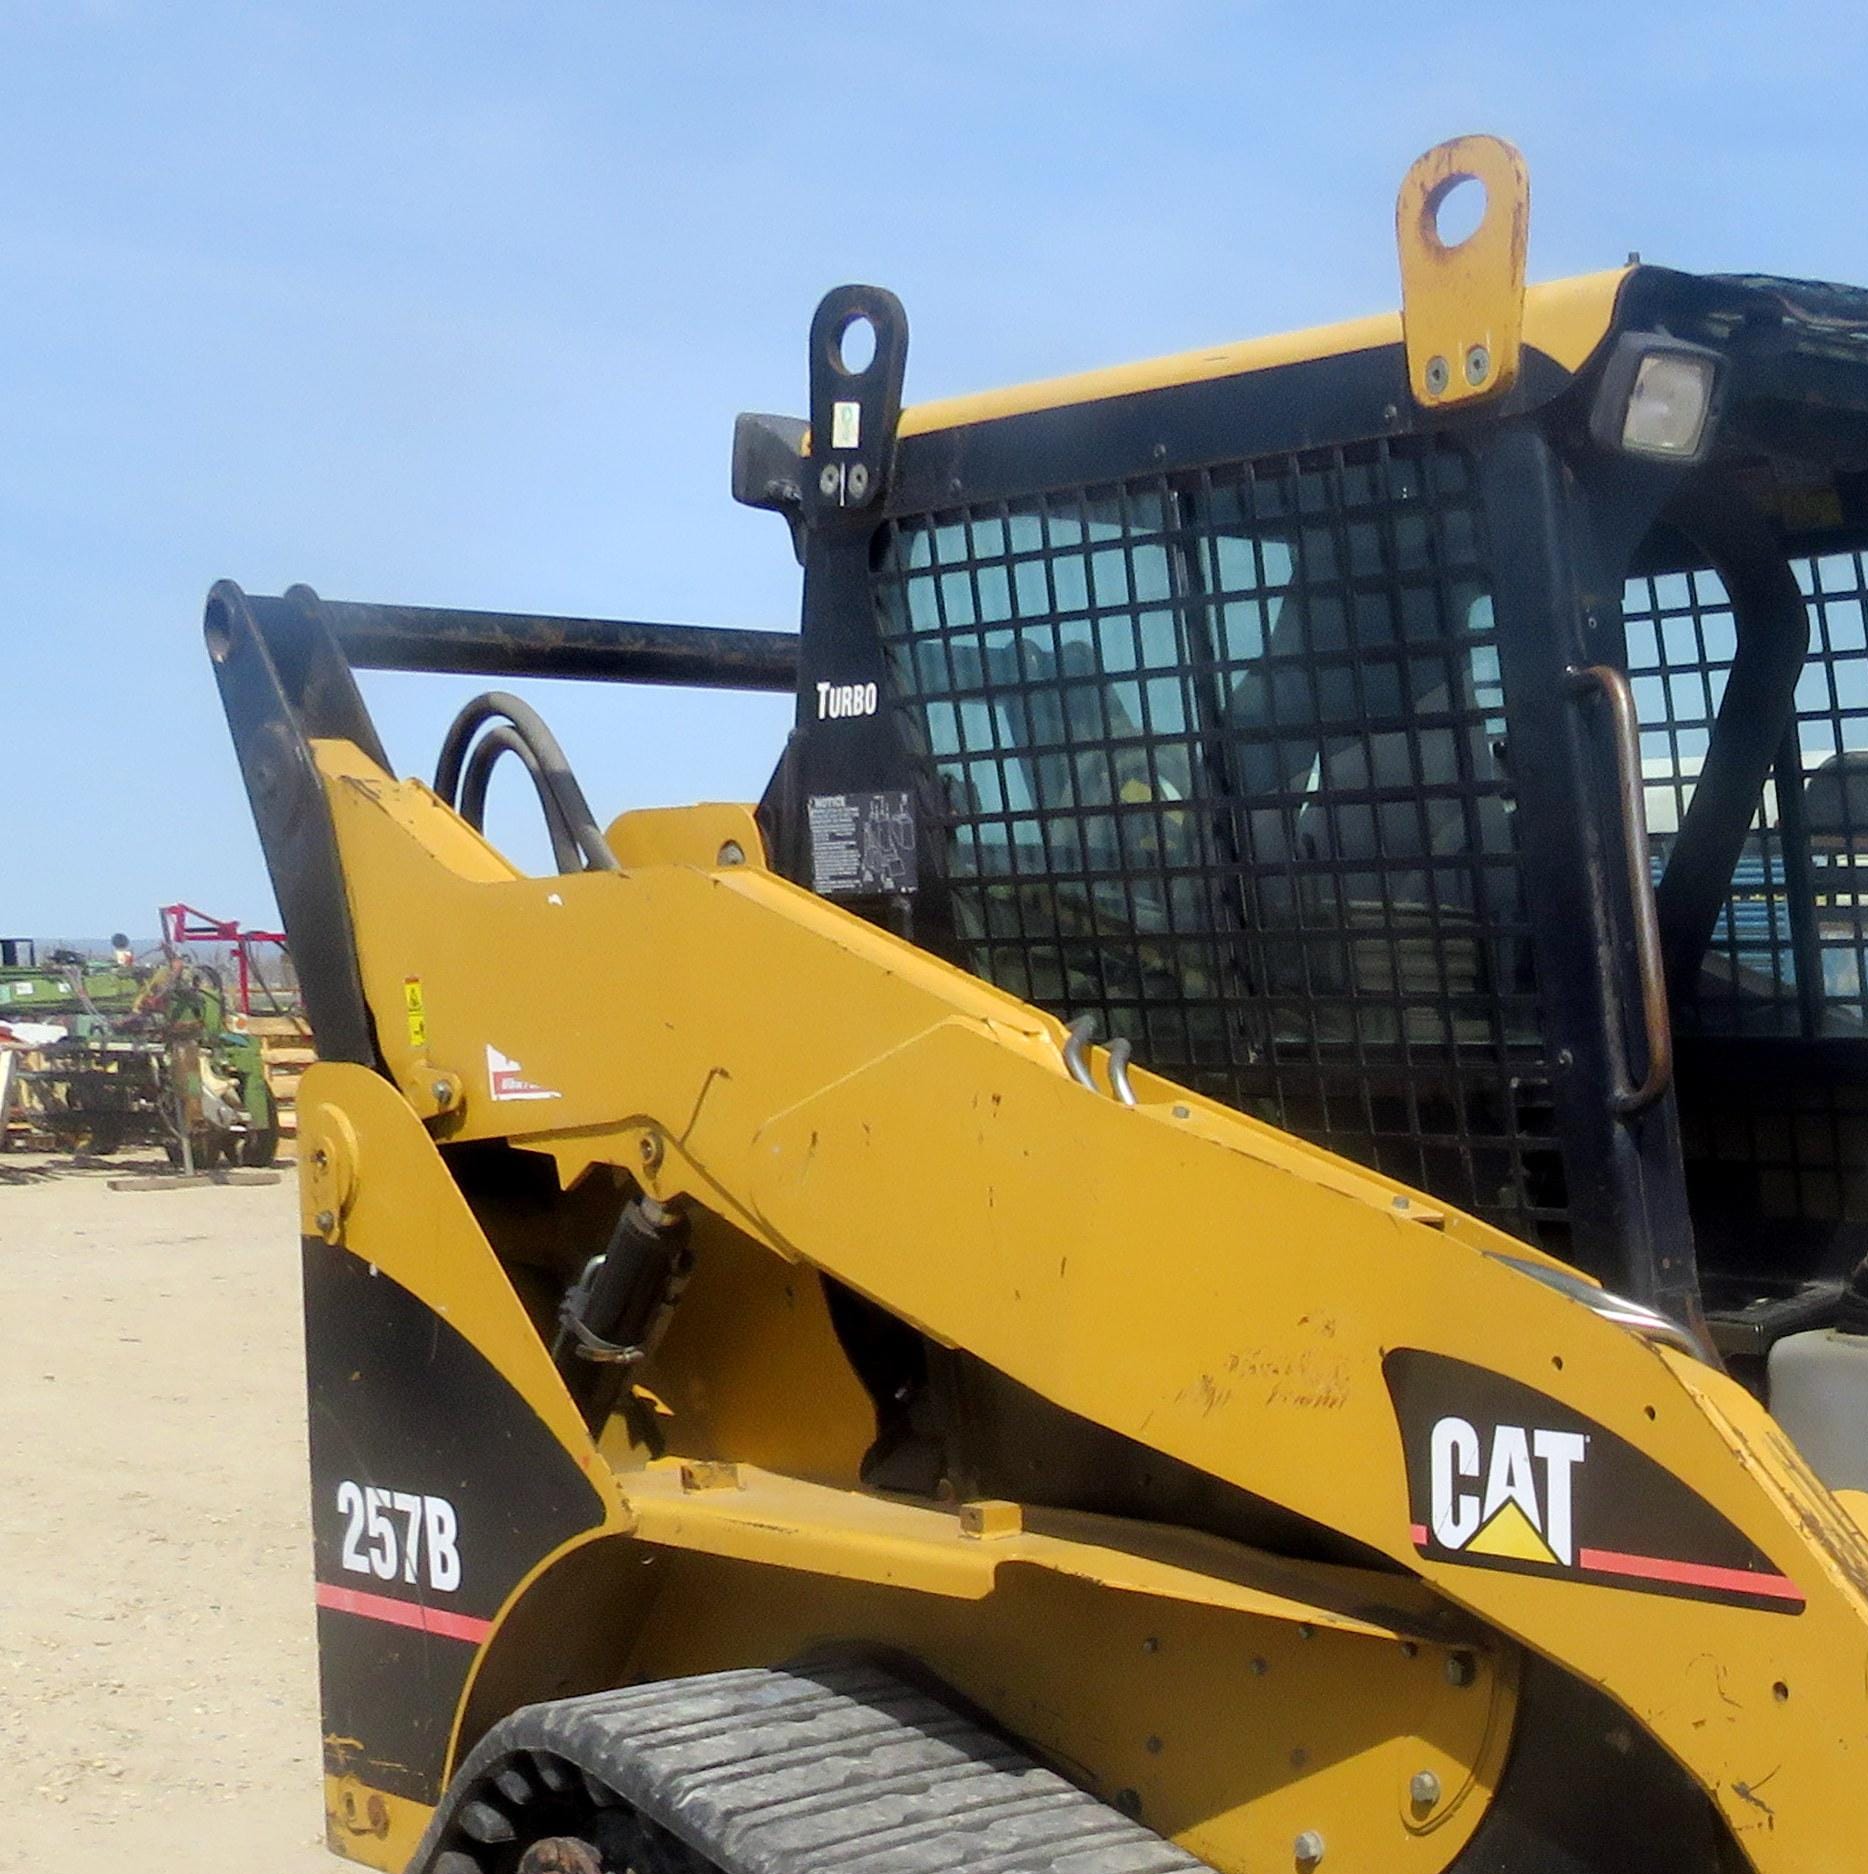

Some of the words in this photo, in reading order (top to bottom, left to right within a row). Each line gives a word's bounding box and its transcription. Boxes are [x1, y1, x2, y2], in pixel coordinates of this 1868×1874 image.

[816, 681, 878, 720] TURBO
[337, 1480, 462, 1593] 257B
[1430, 1416, 1585, 1567] CAT
